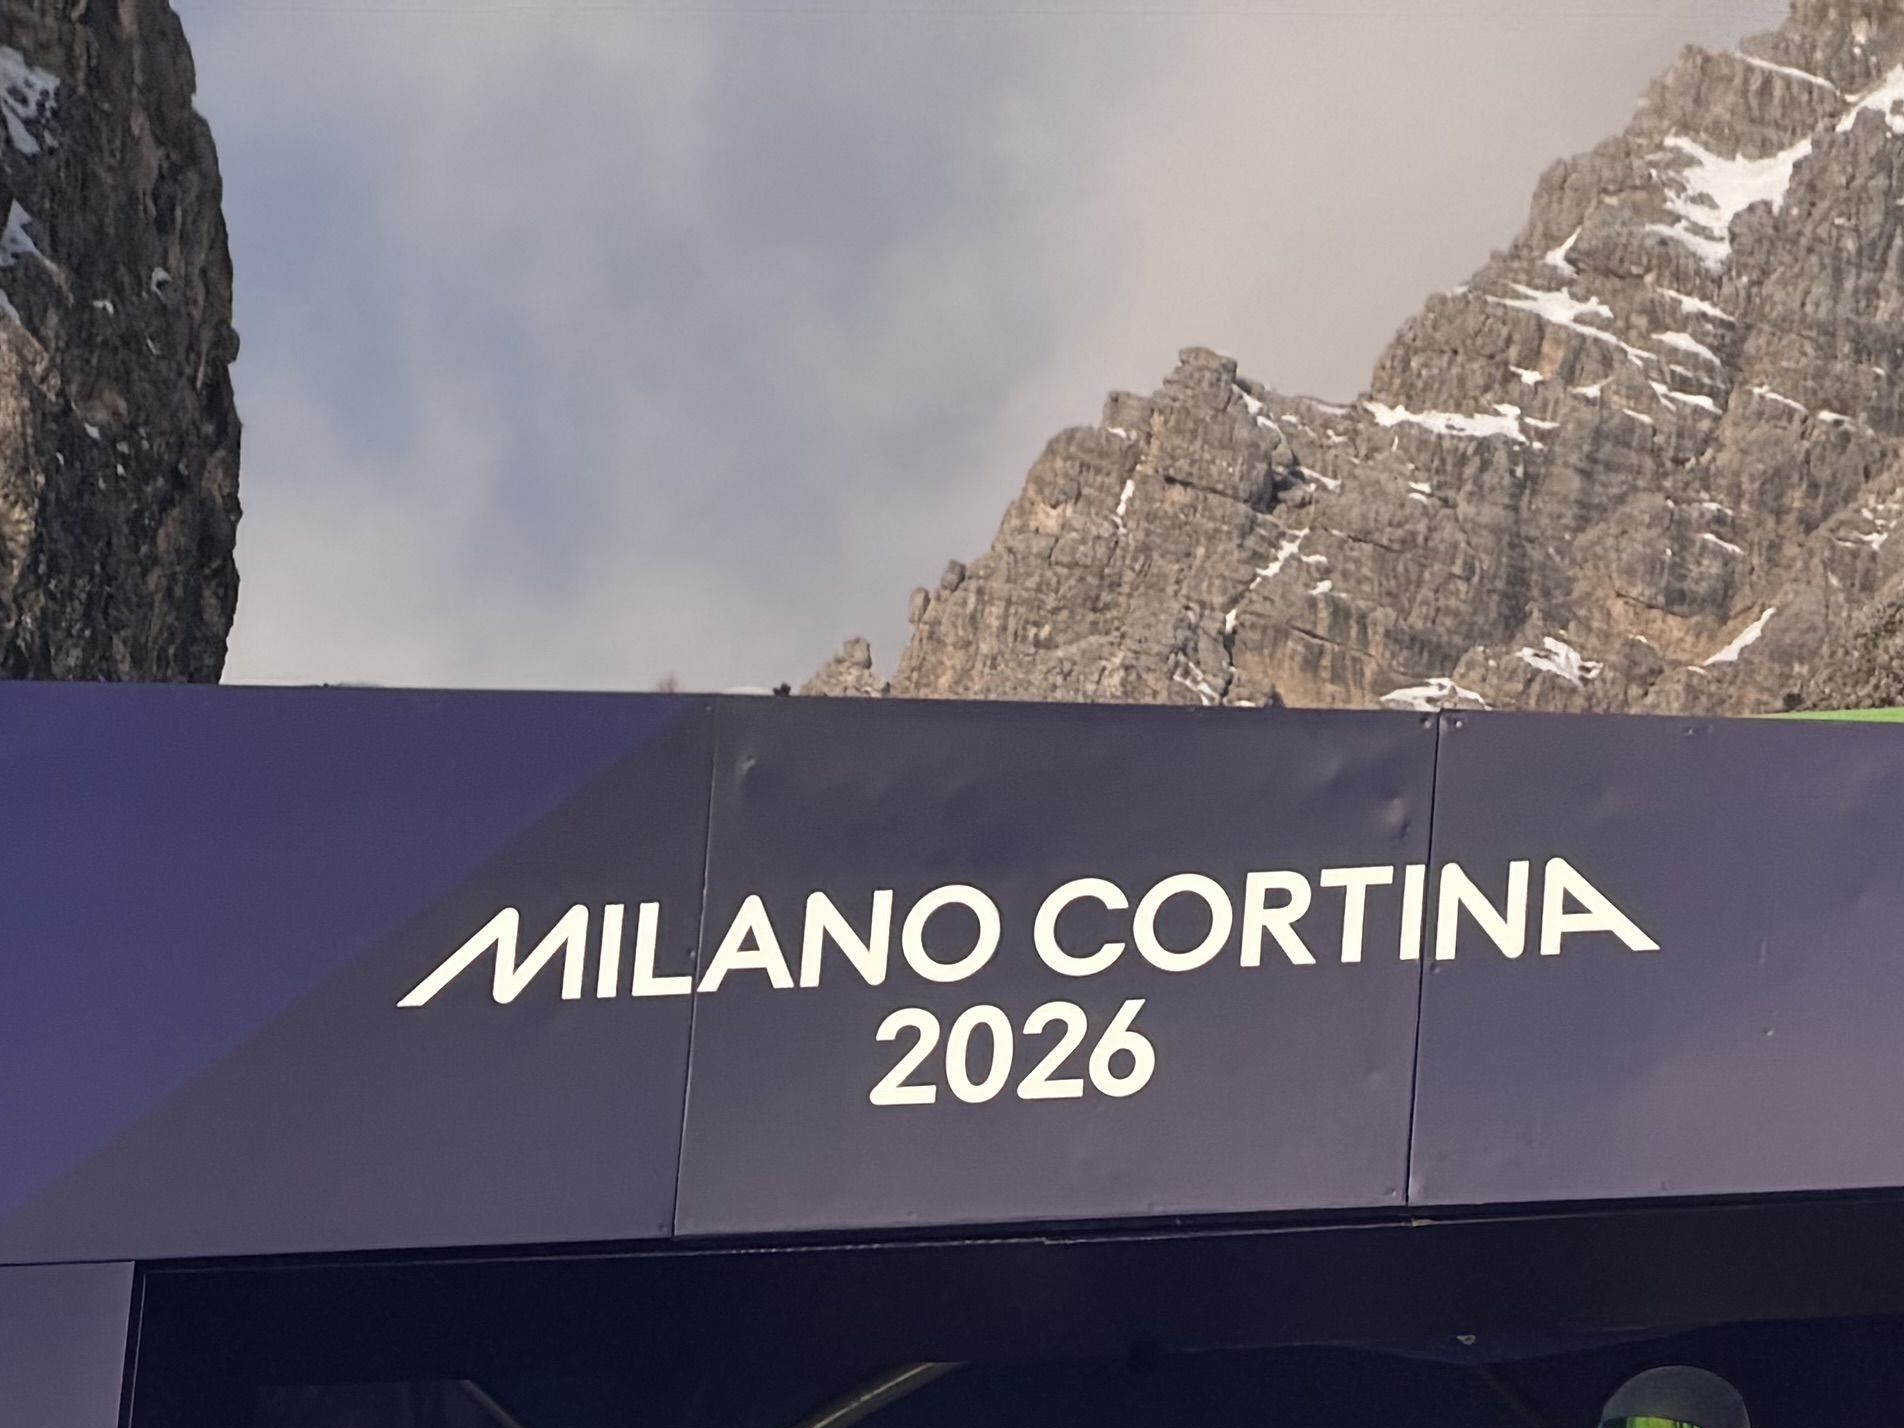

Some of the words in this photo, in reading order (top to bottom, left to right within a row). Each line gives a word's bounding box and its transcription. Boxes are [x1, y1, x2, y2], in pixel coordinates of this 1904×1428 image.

[397, 884, 1002, 1008] MILANO
[1034, 857, 1661, 977] CORTINA
[869, 998, 1156, 1106] 2026
